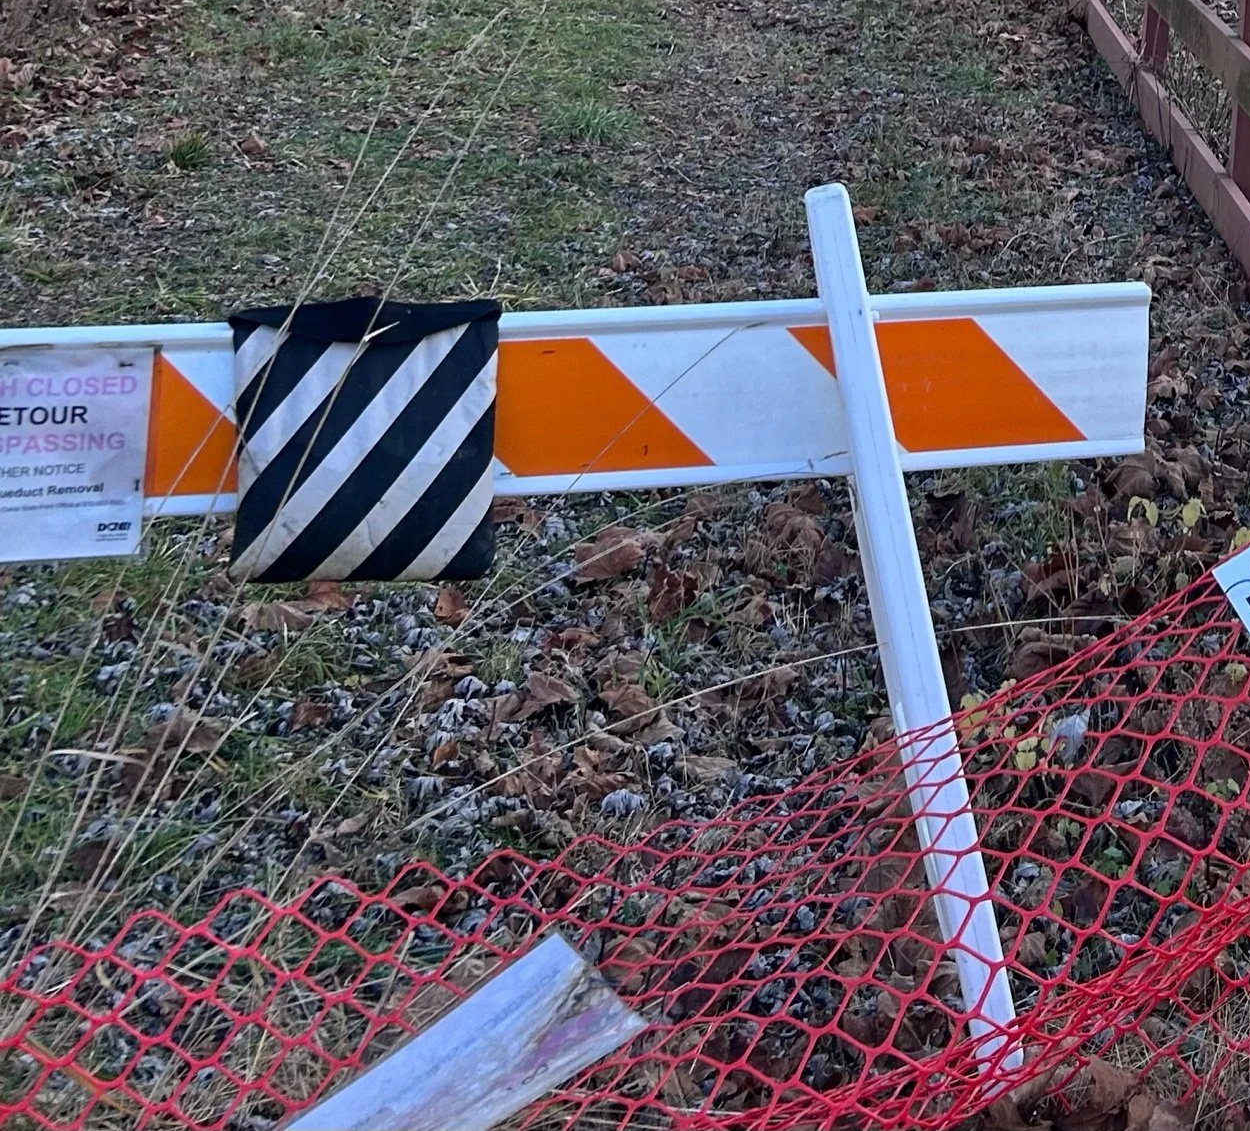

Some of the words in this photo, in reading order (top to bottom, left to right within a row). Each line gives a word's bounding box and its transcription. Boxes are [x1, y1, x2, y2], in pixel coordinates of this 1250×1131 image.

[27, 375, 138, 397] CLOSED
[0, 431, 126, 454] PASSING
[33, 463, 86, 476] NOTICE
[47, 483, 105, 496] Removal
